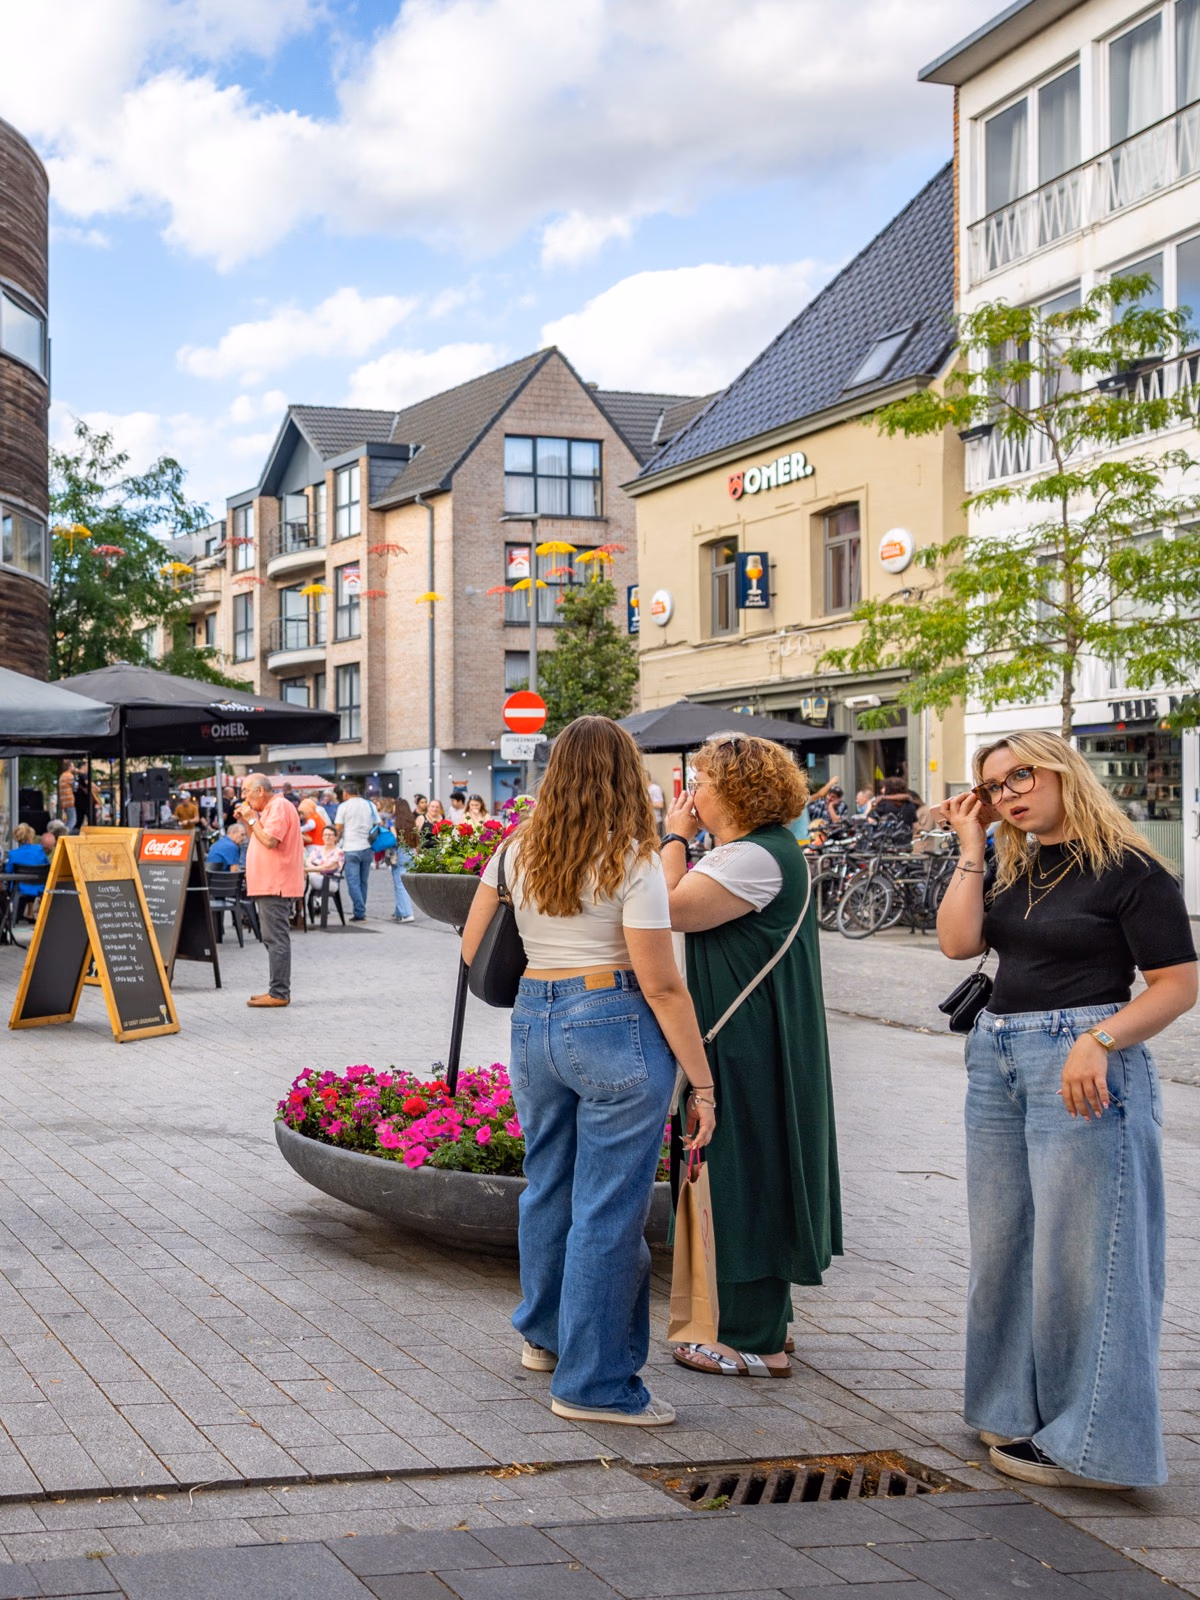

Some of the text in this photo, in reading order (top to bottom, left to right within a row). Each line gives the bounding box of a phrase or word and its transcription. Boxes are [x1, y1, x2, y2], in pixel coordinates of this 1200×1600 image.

[744, 451, 813, 494] OMER.
[1108, 698, 1158, 722] THE
[144, 839, 186, 856] Coca-Cola
